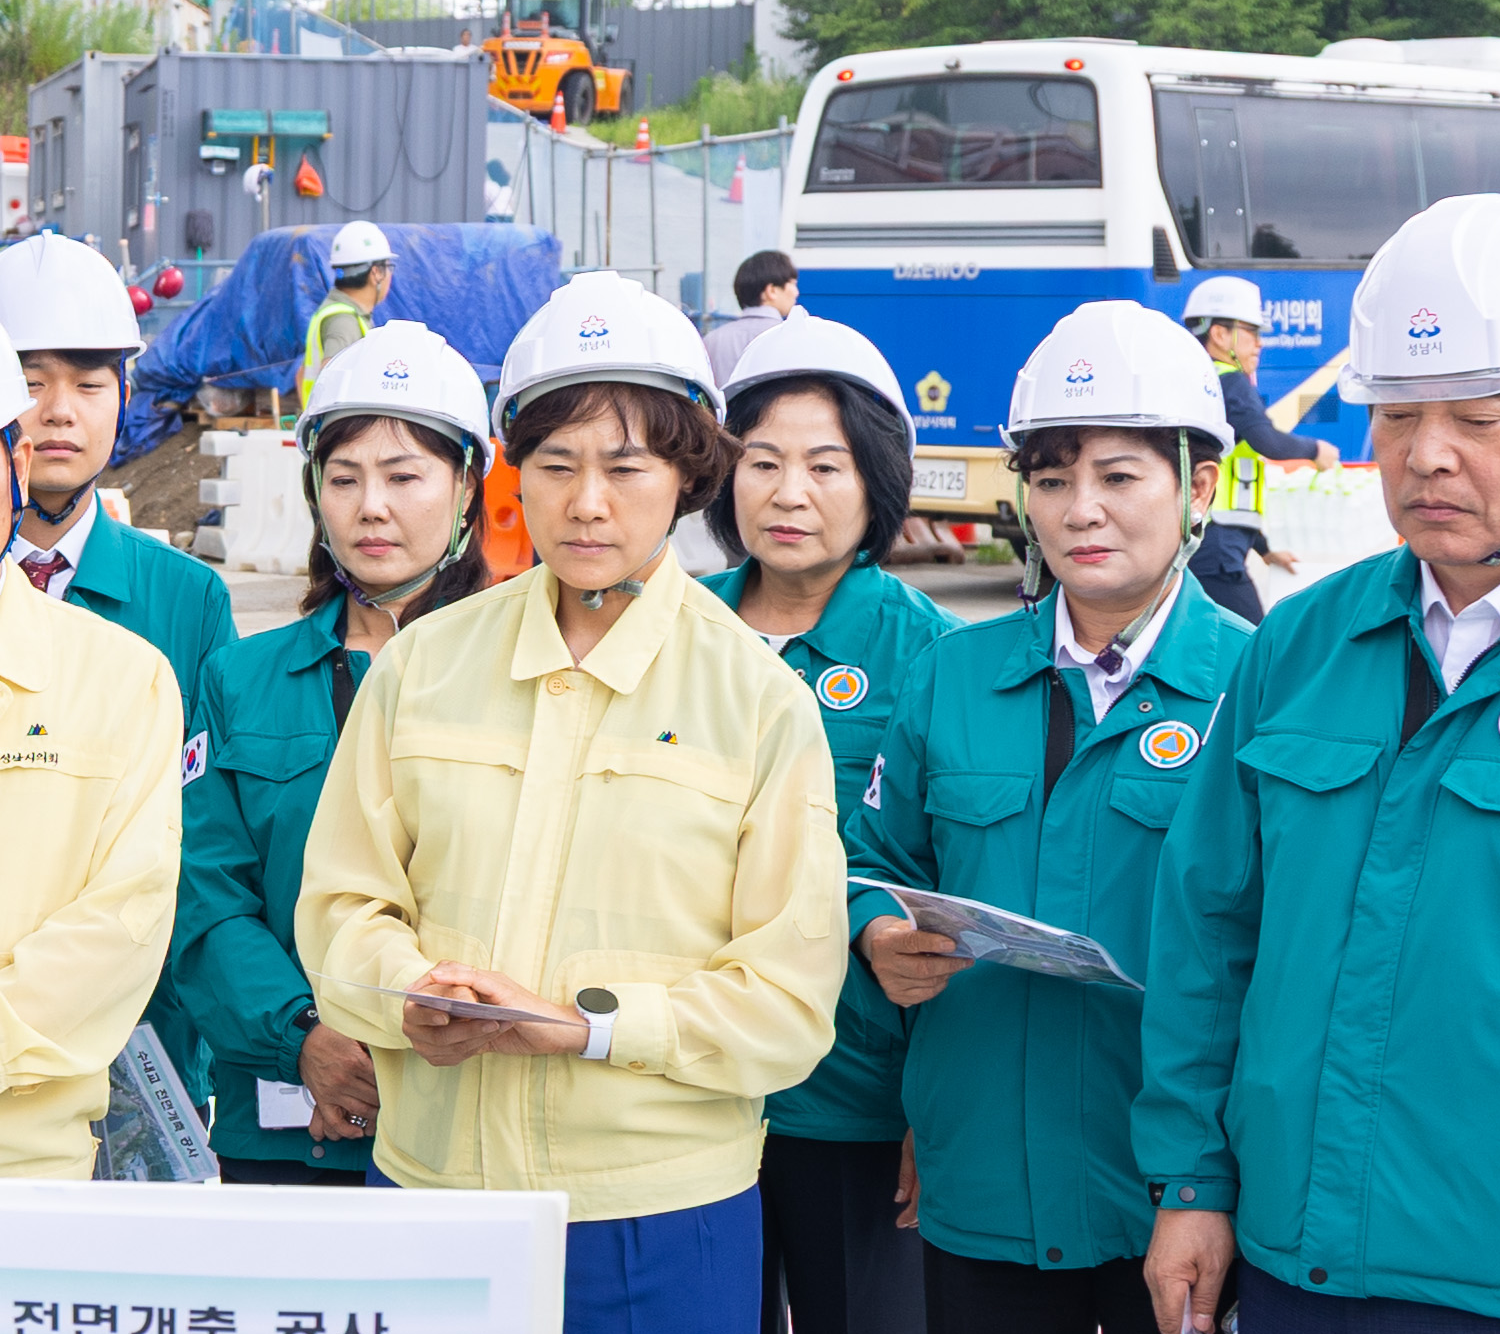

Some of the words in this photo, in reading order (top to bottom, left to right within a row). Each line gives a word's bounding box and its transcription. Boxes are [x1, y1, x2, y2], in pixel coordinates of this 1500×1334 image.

[894, 263, 980, 279] DAEWOO
[578, 339, 611, 352] 성남시
[1407, 341, 1442, 357] 성남시
[381, 380, 409, 392] 성남시
[1064, 385, 1094, 398] 성남시
[0, 751, 59, 766] 성남시의회
[137, 1050, 161, 1084] 수내교
[155, 1088, 186, 1132] 전면개축
[180, 1136, 199, 1158] 공사
